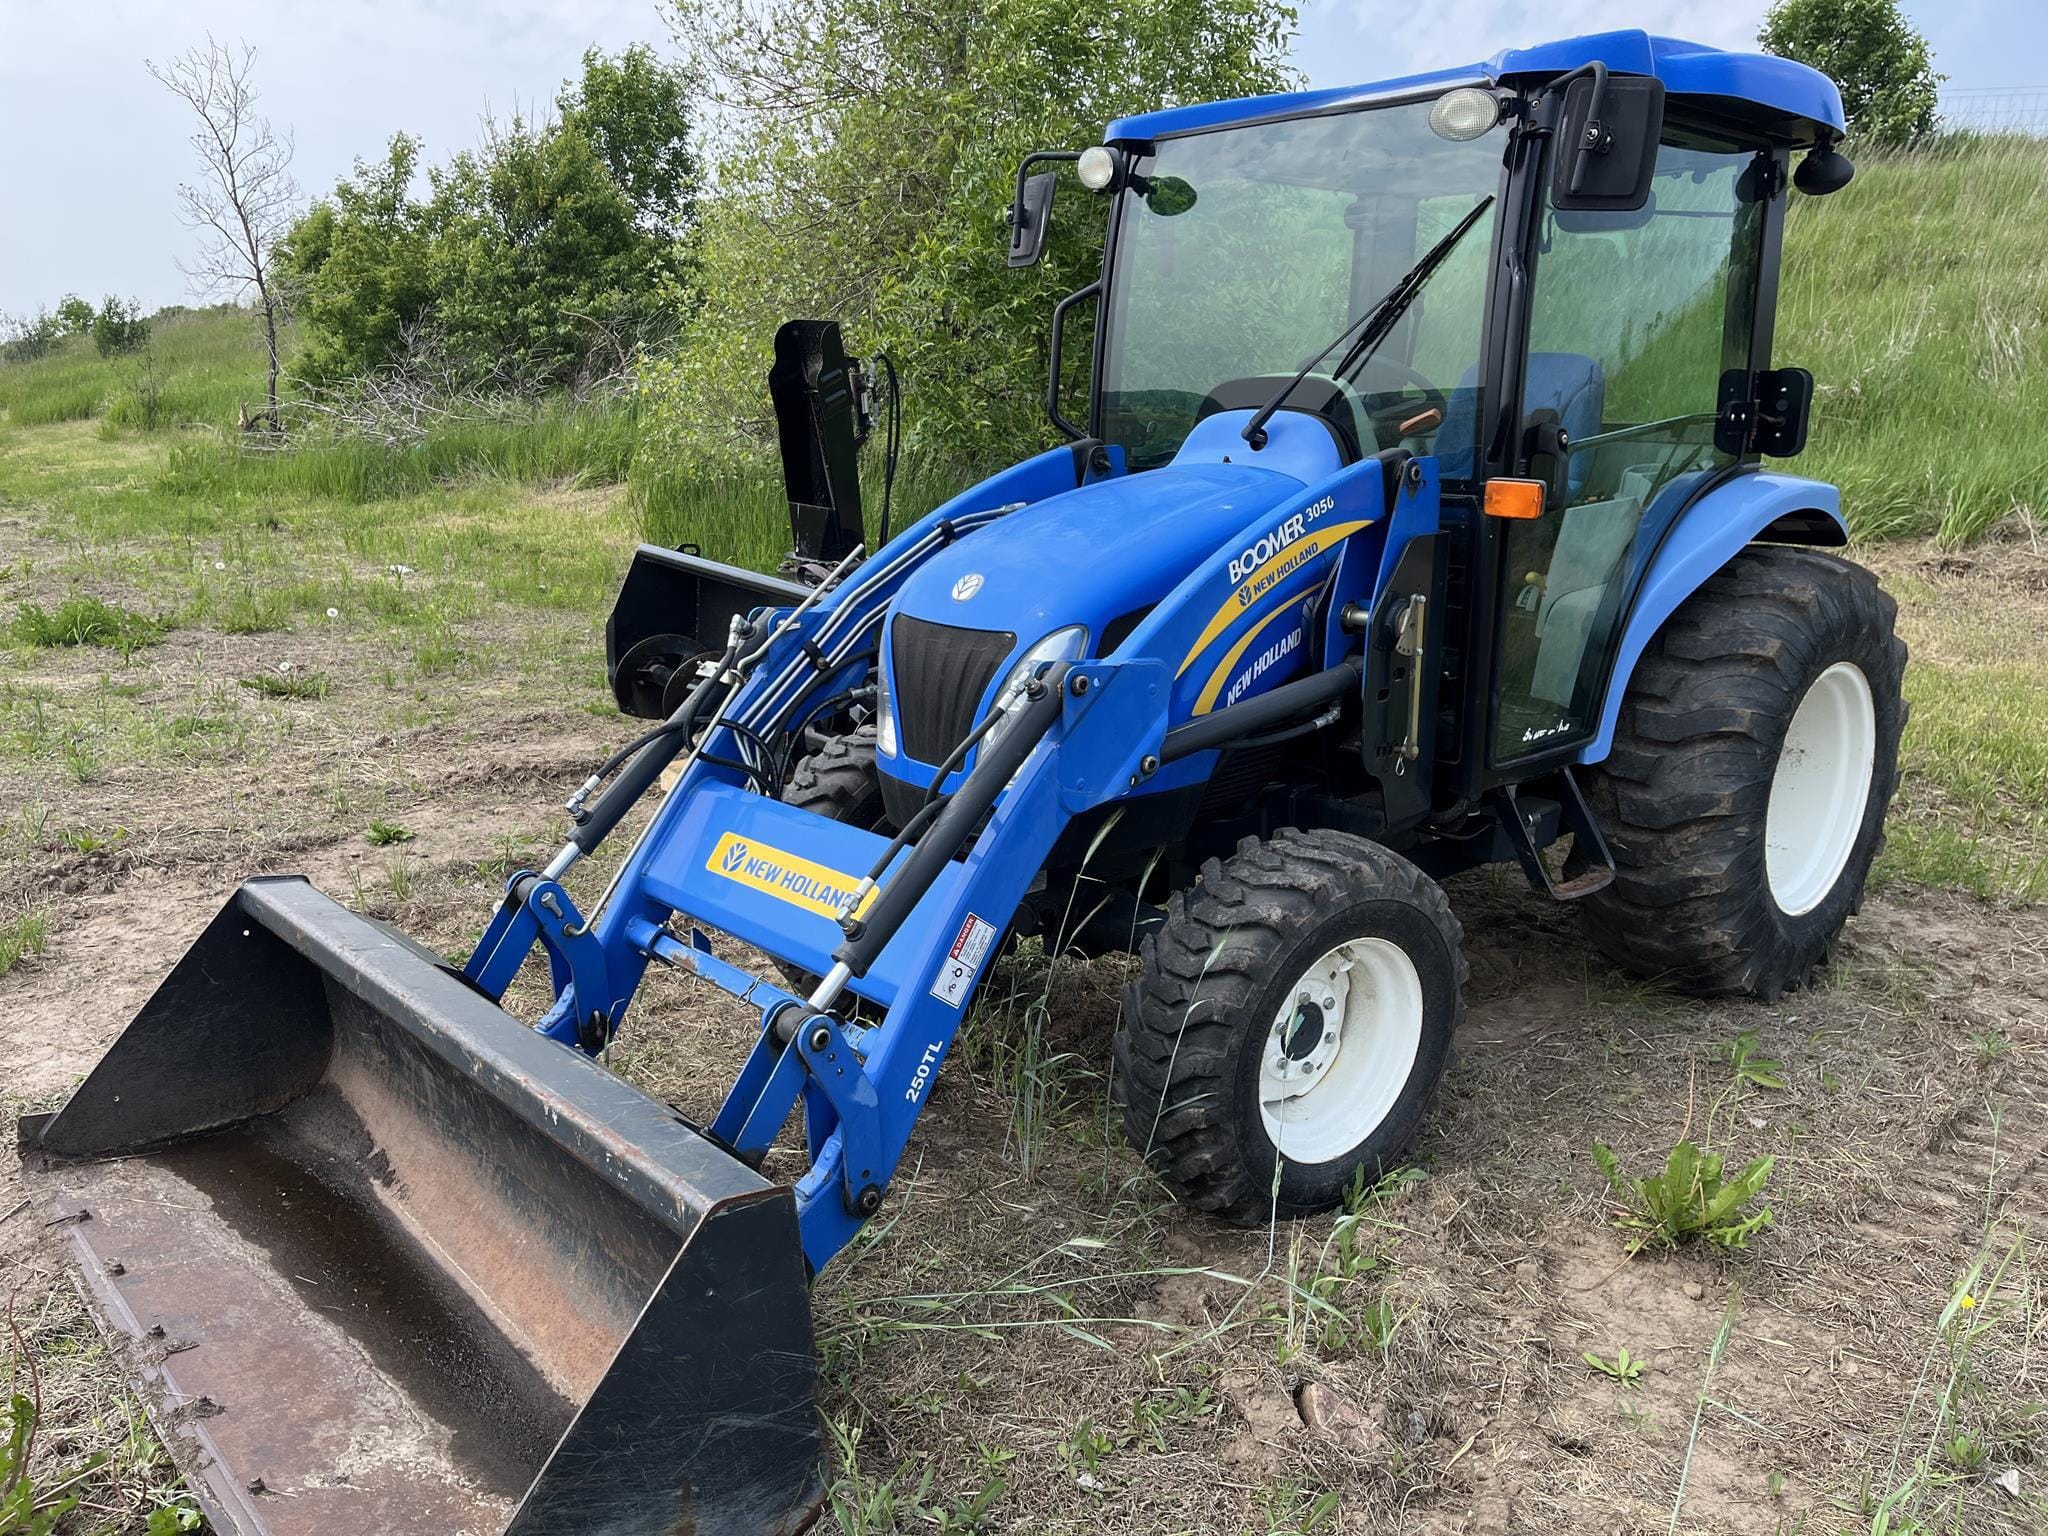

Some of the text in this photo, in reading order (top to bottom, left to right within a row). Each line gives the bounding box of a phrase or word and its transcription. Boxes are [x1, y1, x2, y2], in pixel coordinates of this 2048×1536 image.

[1228, 495, 1335, 585] BOOMER 3050
[1253, 541, 1319, 596] NEW HOLLAND
[1227, 627, 1302, 708] NEW HOLLAND
[743, 857, 783, 883] NEW
[956, 917, 974, 948] DANGER
[906, 1040, 943, 1104] 250TL
